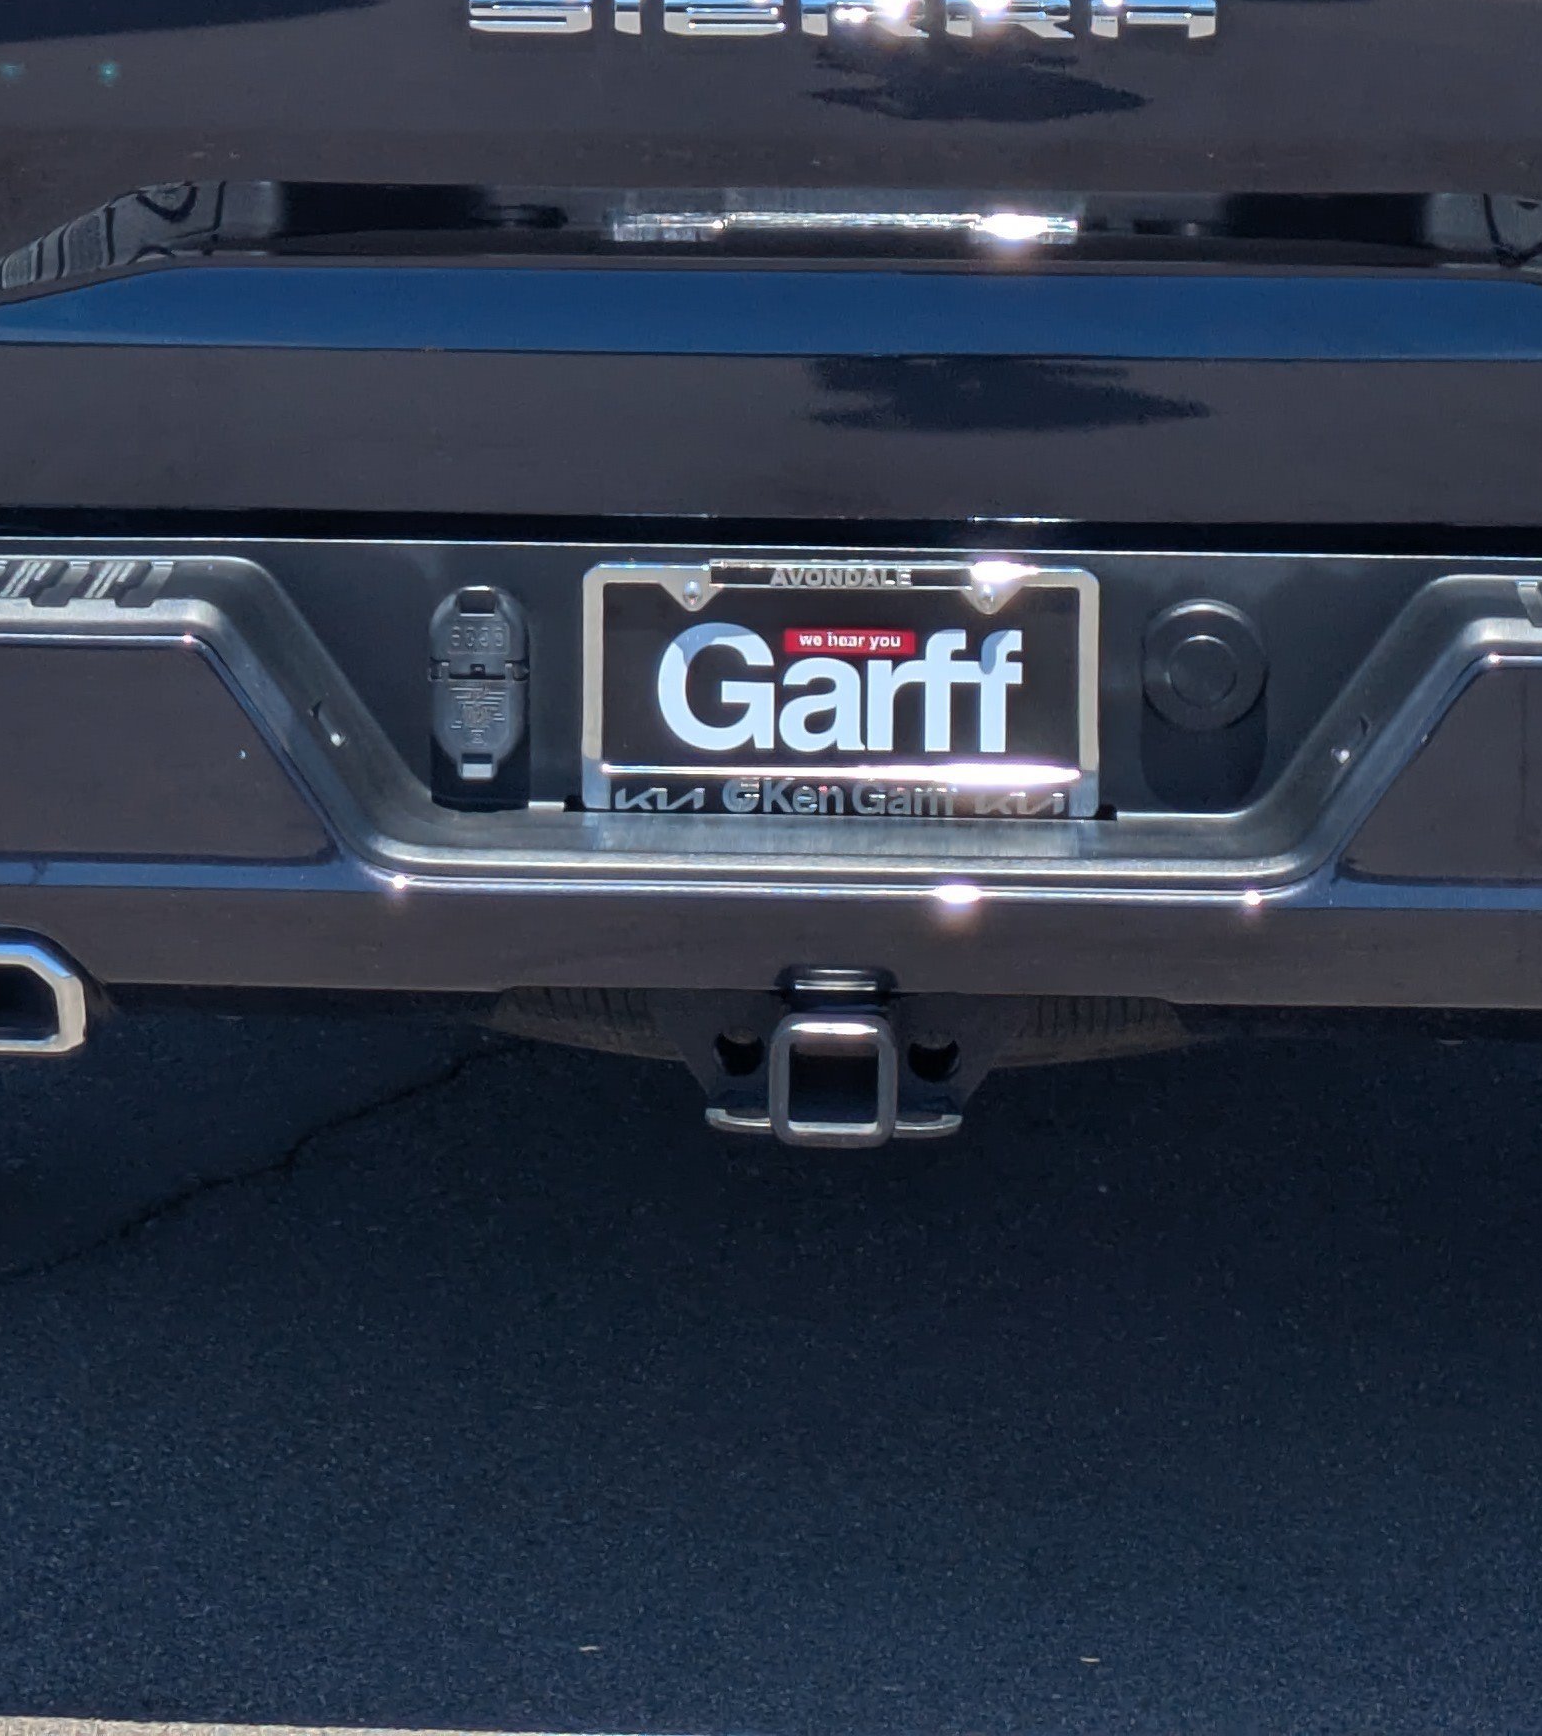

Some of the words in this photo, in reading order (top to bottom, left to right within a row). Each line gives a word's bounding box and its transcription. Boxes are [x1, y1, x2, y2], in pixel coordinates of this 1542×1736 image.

[769, 566, 914, 588] AVONDALE
[799, 634, 823, 648] we
[827, 631, 866, 648] hear
[869, 635, 902, 651] you
[658, 622, 1023, 753] Garff
[763, 777, 845, 814] Ken
